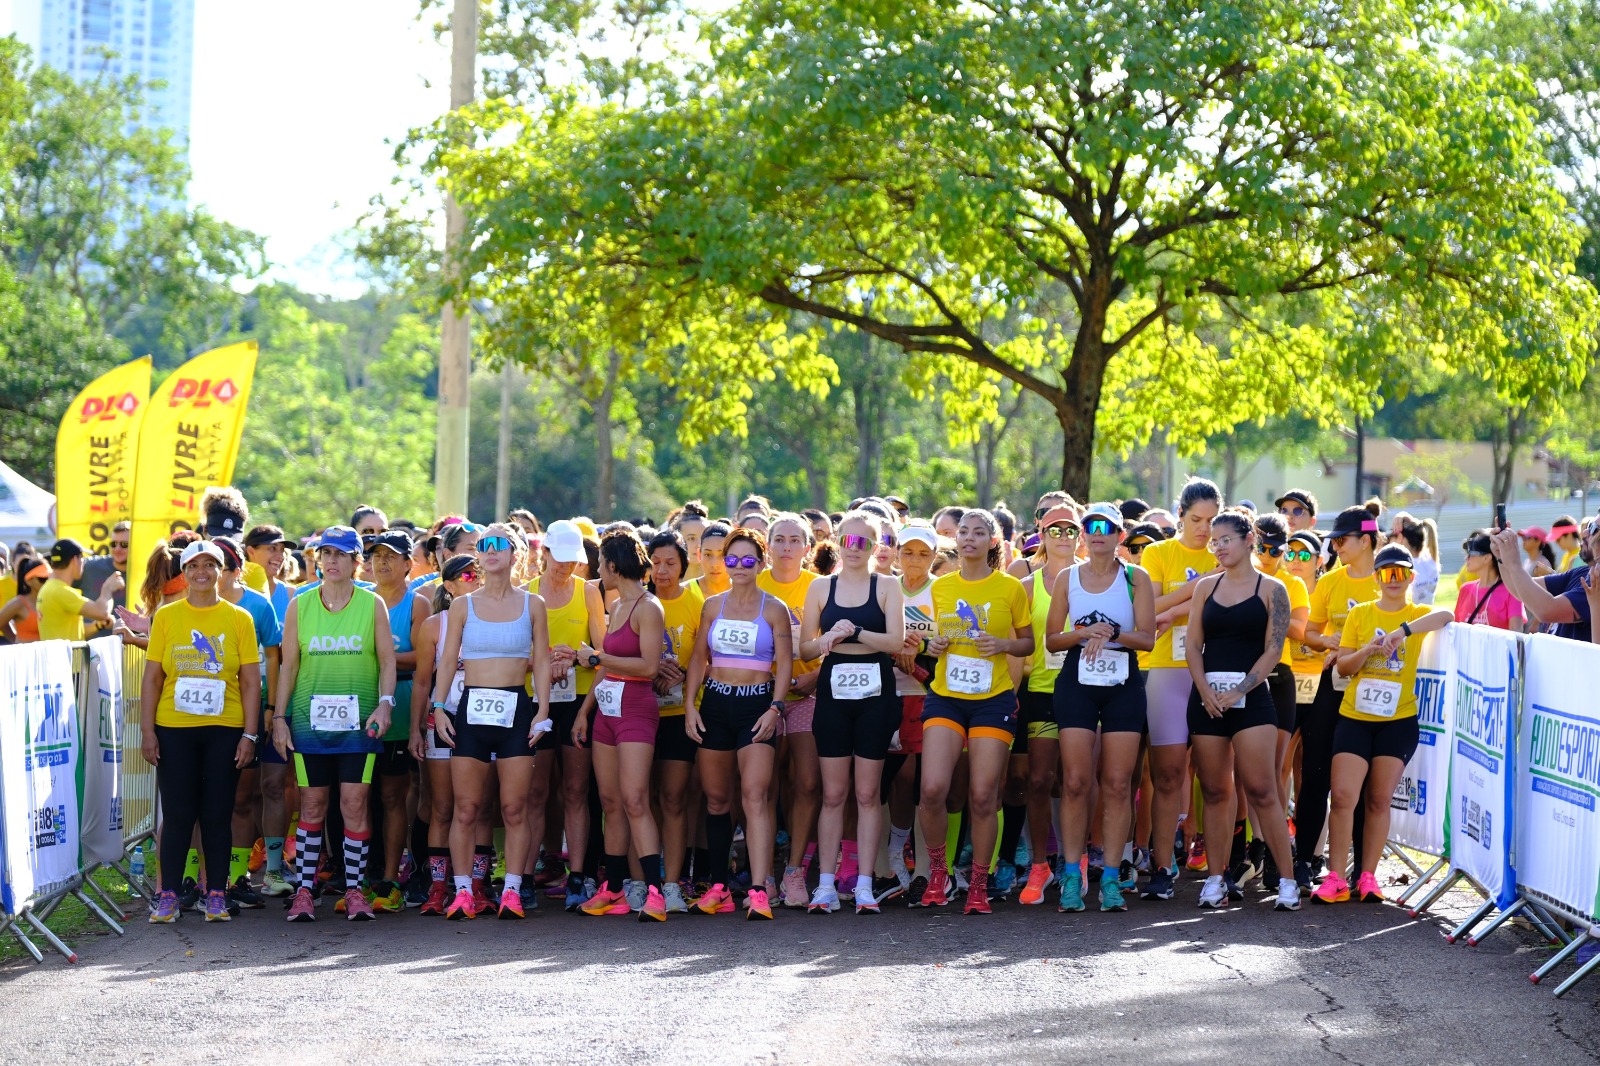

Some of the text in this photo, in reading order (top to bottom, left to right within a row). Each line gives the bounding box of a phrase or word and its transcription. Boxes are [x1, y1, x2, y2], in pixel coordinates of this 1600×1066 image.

[89, 435, 109, 513] LIVRE
[171, 421, 199, 511] LIVRE
[308, 634, 362, 652] ADAC
[717, 628, 750, 645] 153
[949, 667, 981, 684] 413
[1085, 660, 1118, 674] 334
[709, 680, 732, 696] PRO
[735, 683, 766, 697] NIKE
[837, 673, 870, 688] 228
[180, 689, 213, 705] 414
[1362, 687, 1393, 705] 179
[317, 705, 348, 719] 276
[473, 698, 505, 714] 376
